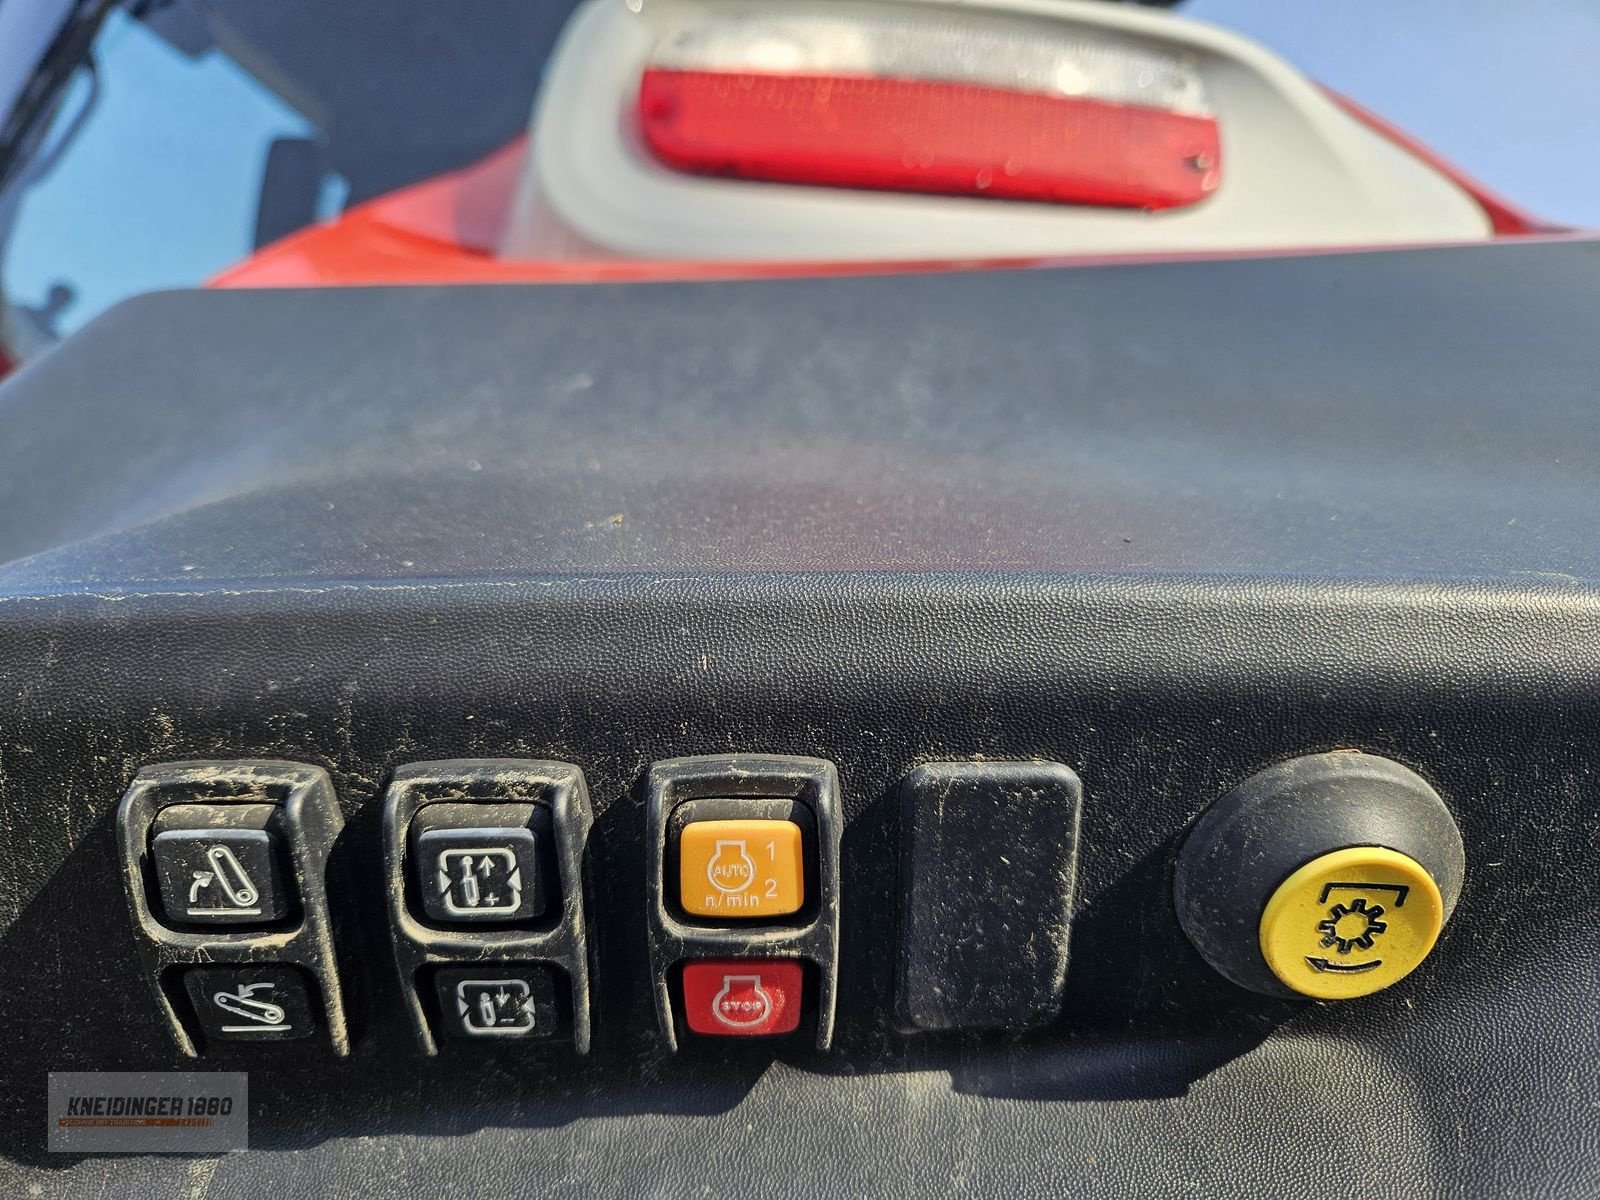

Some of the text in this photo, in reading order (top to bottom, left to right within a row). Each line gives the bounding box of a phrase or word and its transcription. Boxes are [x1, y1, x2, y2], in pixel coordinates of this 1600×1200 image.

[766, 840, 776, 862] 1
[714, 863, 750, 878] AUTO
[764, 878, 778, 898] 2
[705, 891, 760, 908] n/min
[721, 1001, 763, 1012] STOP
